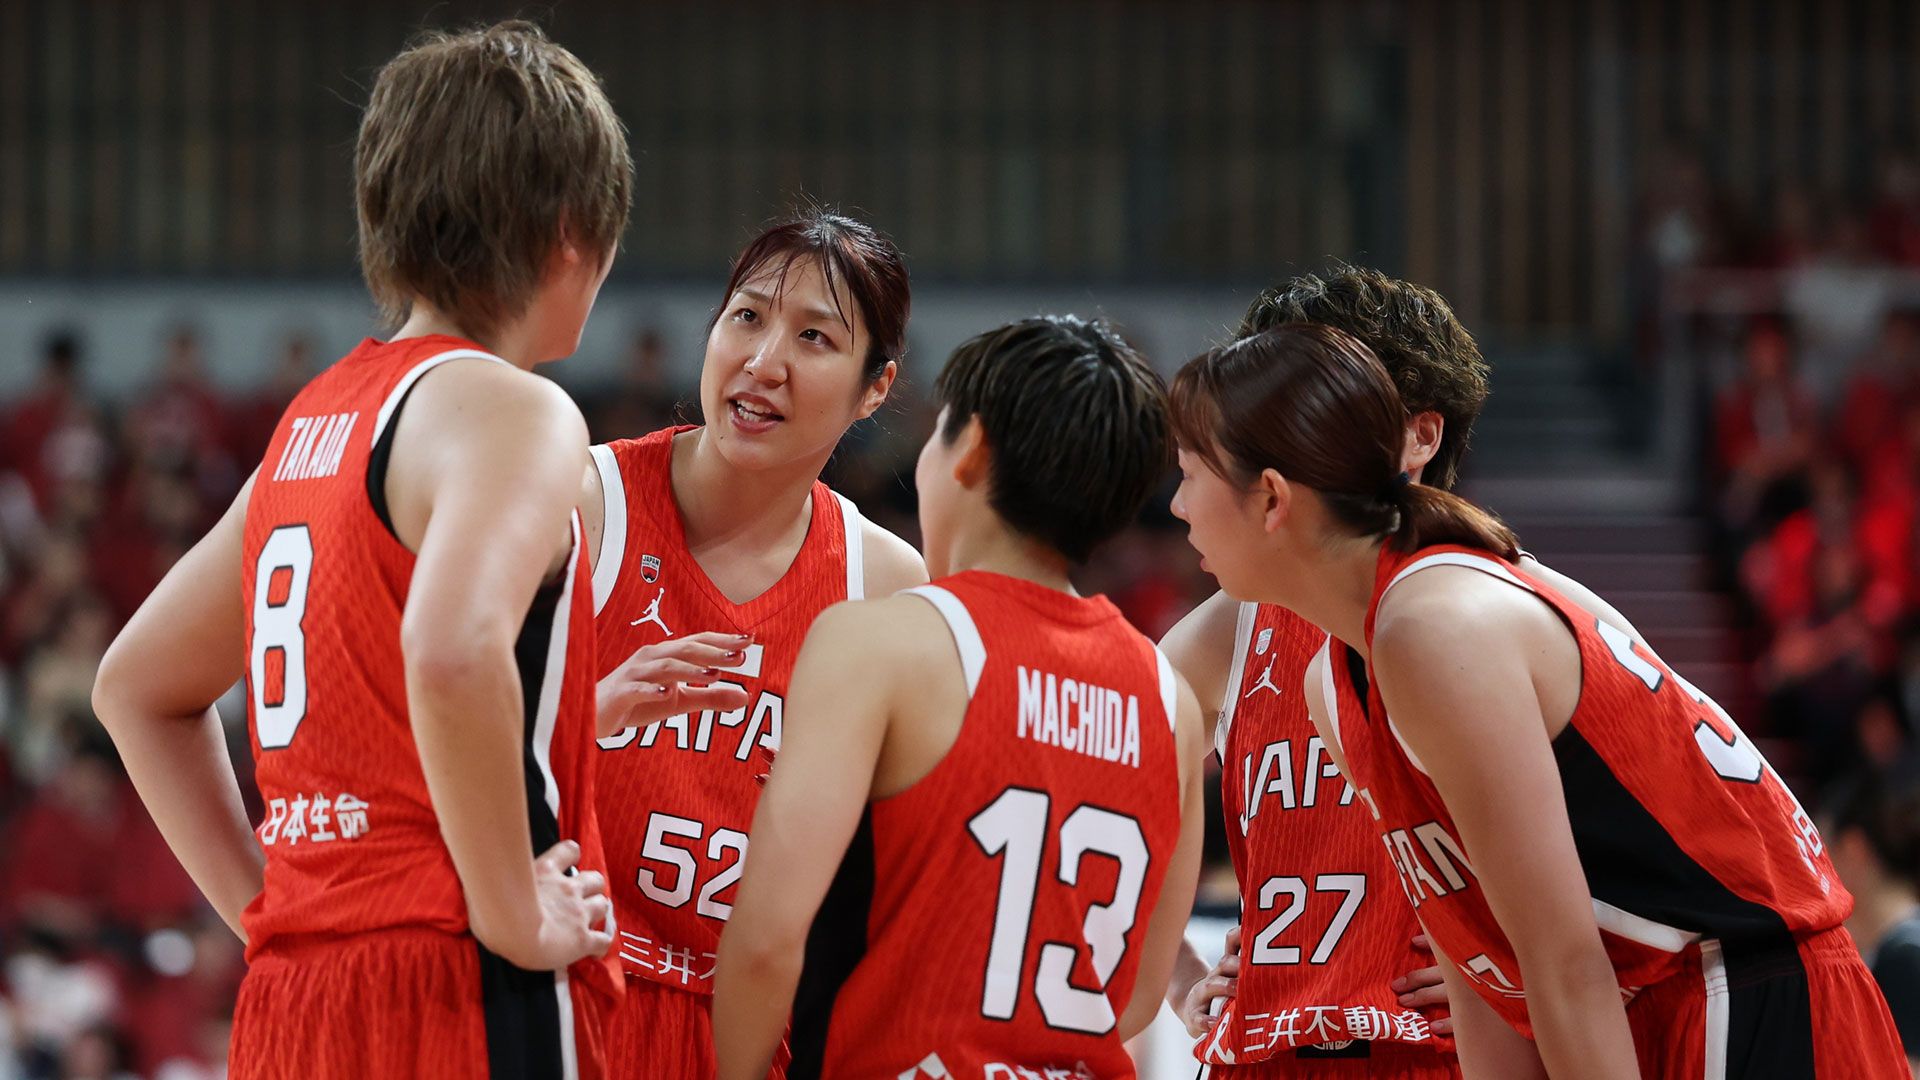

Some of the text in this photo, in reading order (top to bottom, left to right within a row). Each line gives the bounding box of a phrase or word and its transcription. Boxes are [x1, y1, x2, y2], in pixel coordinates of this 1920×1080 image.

[273, 411, 359, 481] TAKADA
[250, 523, 314, 750] 8
[1016, 665, 1141, 769] MACHIDA
[261, 792, 371, 846] 日本生命
[1239, 735, 1357, 838] JAP
[637, 810, 750, 923] 52
[966, 785, 1151, 1036] 13
[1251, 872, 1367, 966] 27
[1243, 1005, 1432, 1053] 三井不動産
